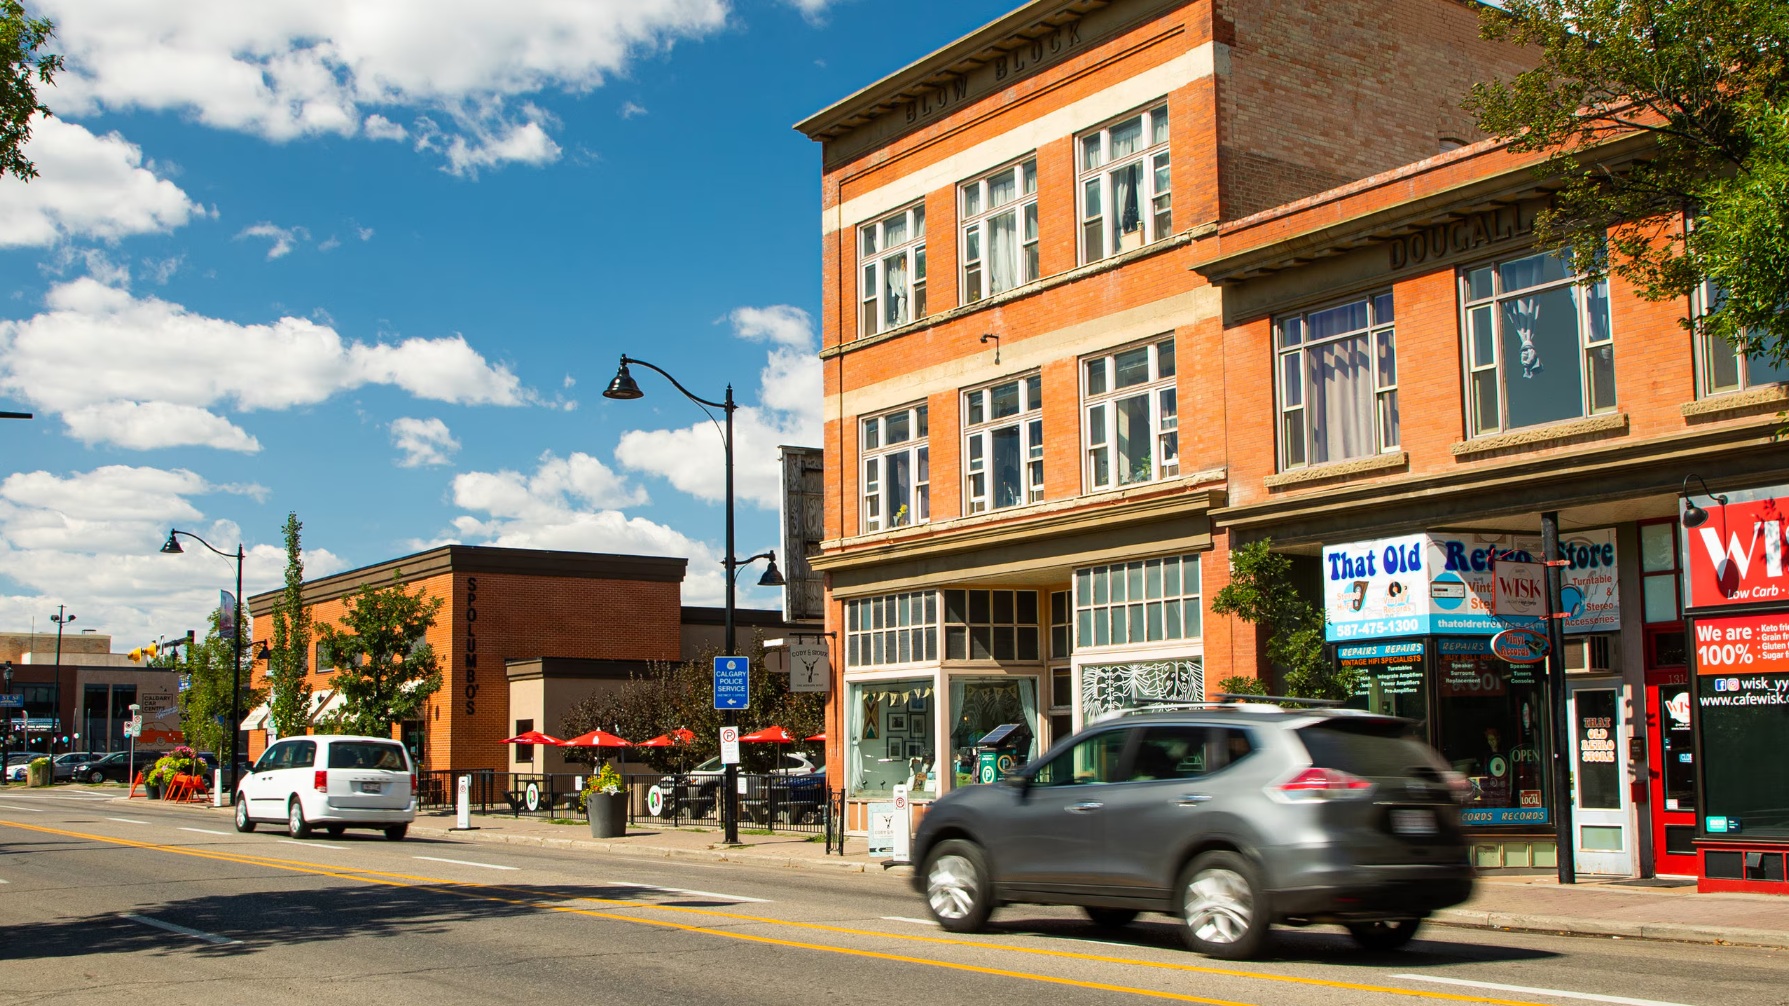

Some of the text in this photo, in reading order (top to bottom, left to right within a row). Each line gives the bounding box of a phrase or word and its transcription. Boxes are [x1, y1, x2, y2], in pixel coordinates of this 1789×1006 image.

[906, 19, 1082, 124] BLOW BLOCK
[1389, 203, 1534, 270] DOUGALL
[1699, 519, 1789, 581] WI
[1328, 550, 1376, 581] That
[1383, 542, 1421, 575] Old
[1572, 574, 1612, 585] Turntable
[1499, 576, 1542, 599] WISK
[1606, 587, 1612, 596] &
[1727, 584, 1779, 599] Low Carb
[1337, 592, 1360, 601] Stereo
[1383, 596, 1403, 605] Vinyl
[1383, 605, 1411, 613] Records
[1586, 602, 1614, 611] Stereo
[1564, 615, 1615, 626] Accessories
[1337, 619, 1419, 637] 587-475-1300
[1696, 625, 1752, 642] We are
[1761, 624, 1778, 632] Keto
[1505, 632, 1526, 646] Vinyl
[1761, 633, 1781, 641] Grain
[465, 577, 479, 715] SPOLUMBO'S
[1341, 643, 1422, 657] REPAIRS REPAIRS
[1442, 643, 1484, 651] REPAIRS
[1500, 645, 1530, 656] Records
[1762, 642, 1786, 650] Gluten
[791, 649, 806, 657] CODY
[1698, 644, 1753, 666] 100%
[1762, 651, 1784, 661] Sugar
[1341, 655, 1421, 667] VINTAGE HIFI SPECIALISTS
[1741, 676, 1789, 691] wisk_yy
[1583, 717, 1611, 728] THAT
[1587, 729, 1608, 739] OLD
[1581, 740, 1615, 750] RETRO
[1511, 749, 1540, 762] OPEN
[1582, 751, 1615, 762] STORE
[1521, 796, 1539, 804] LOCAL
[1461, 811, 1545, 822] CORDS RECORDS
